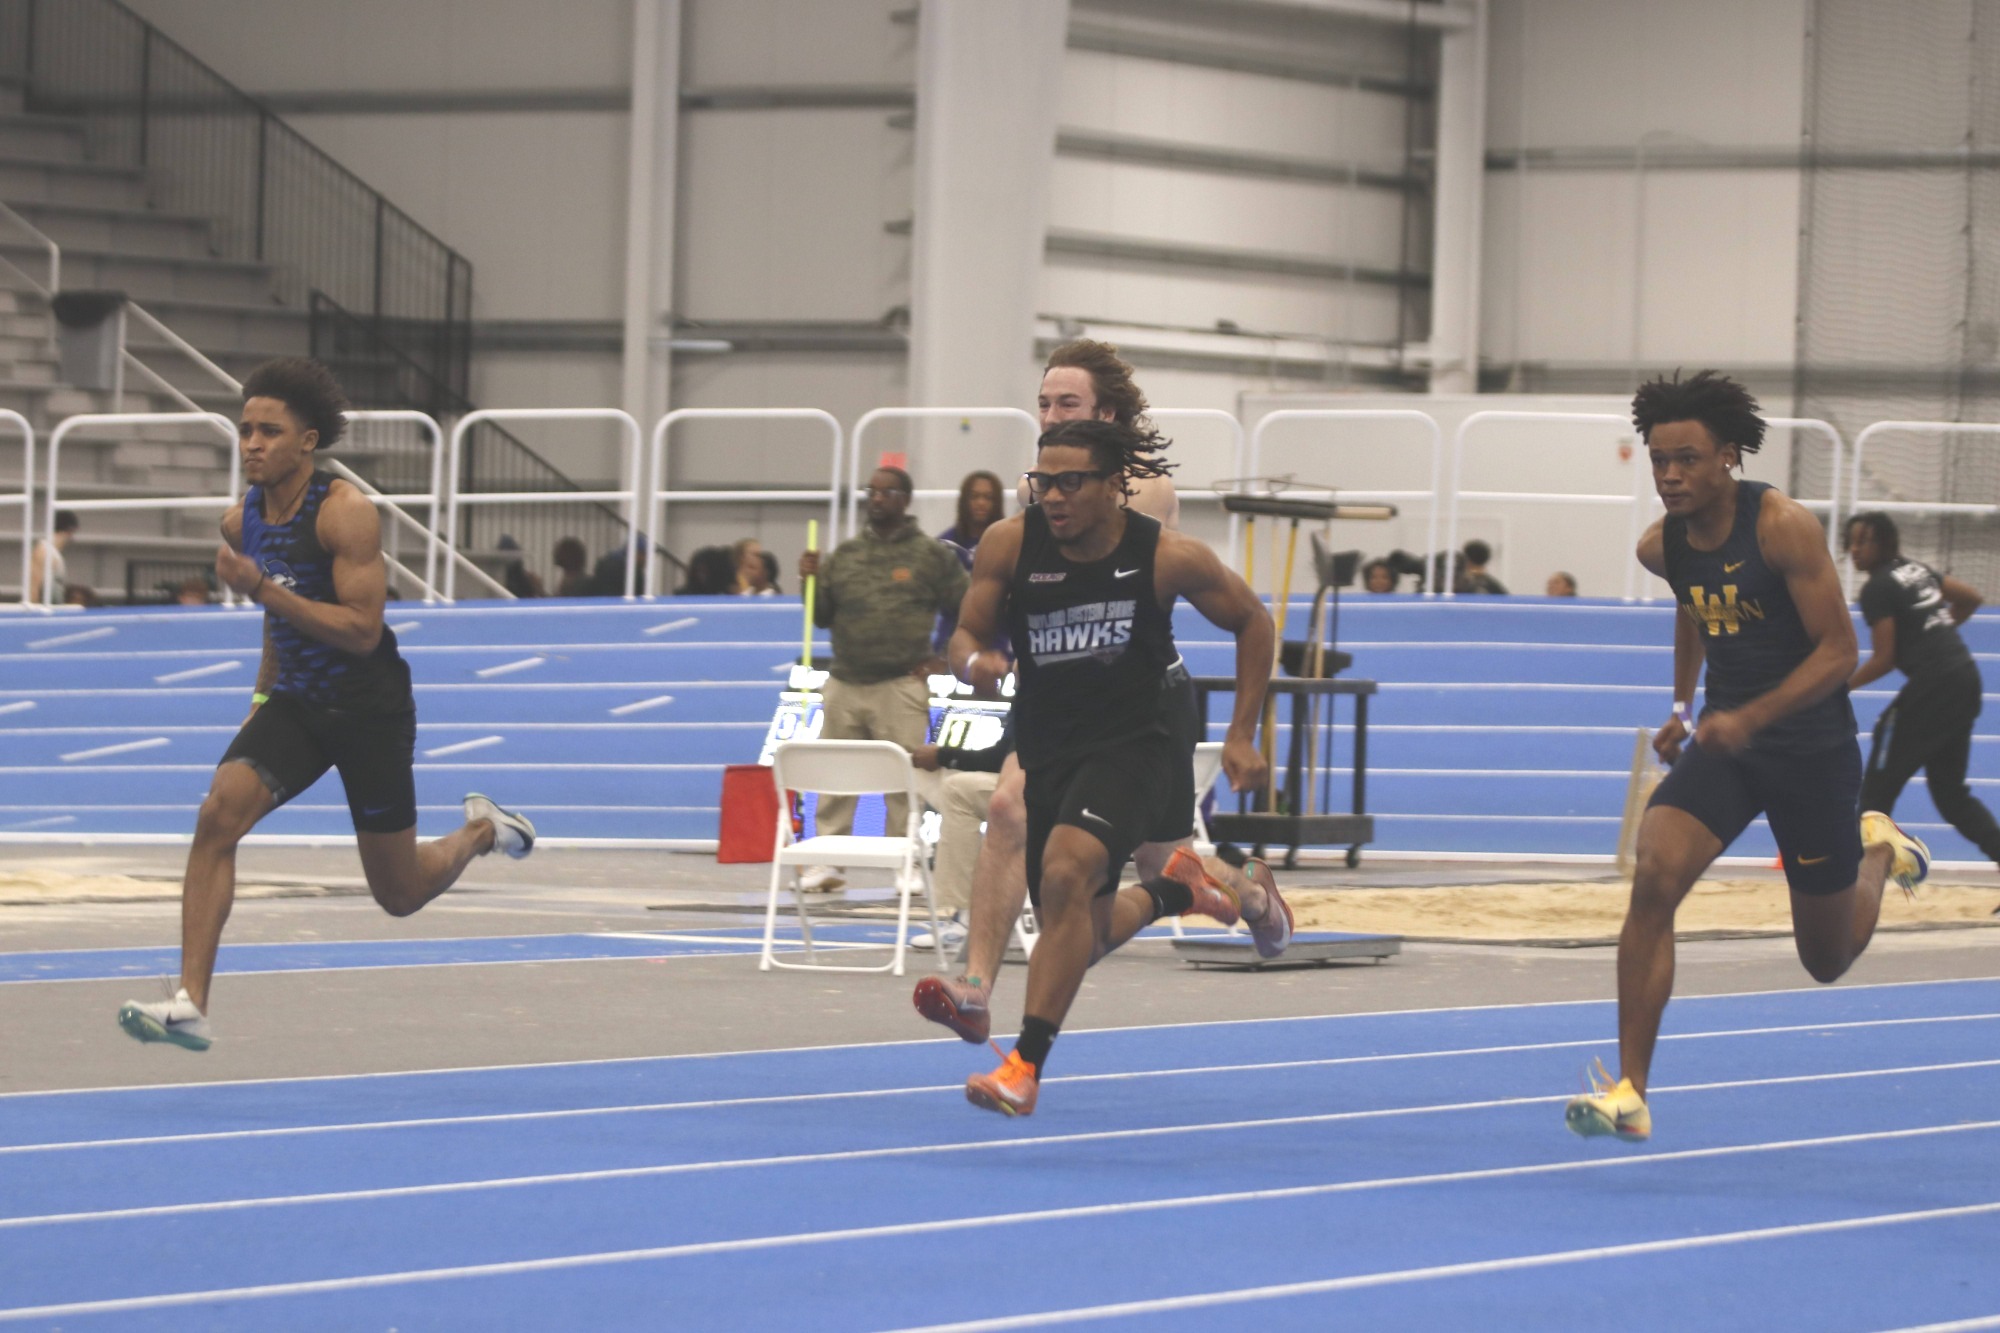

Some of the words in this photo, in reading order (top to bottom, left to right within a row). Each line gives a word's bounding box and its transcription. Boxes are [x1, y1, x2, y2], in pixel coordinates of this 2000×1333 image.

[1067, 601, 1106, 625] EASTERN
[1107, 599, 1137, 620] SHORE
[1029, 618, 1133, 653] HAWKS
